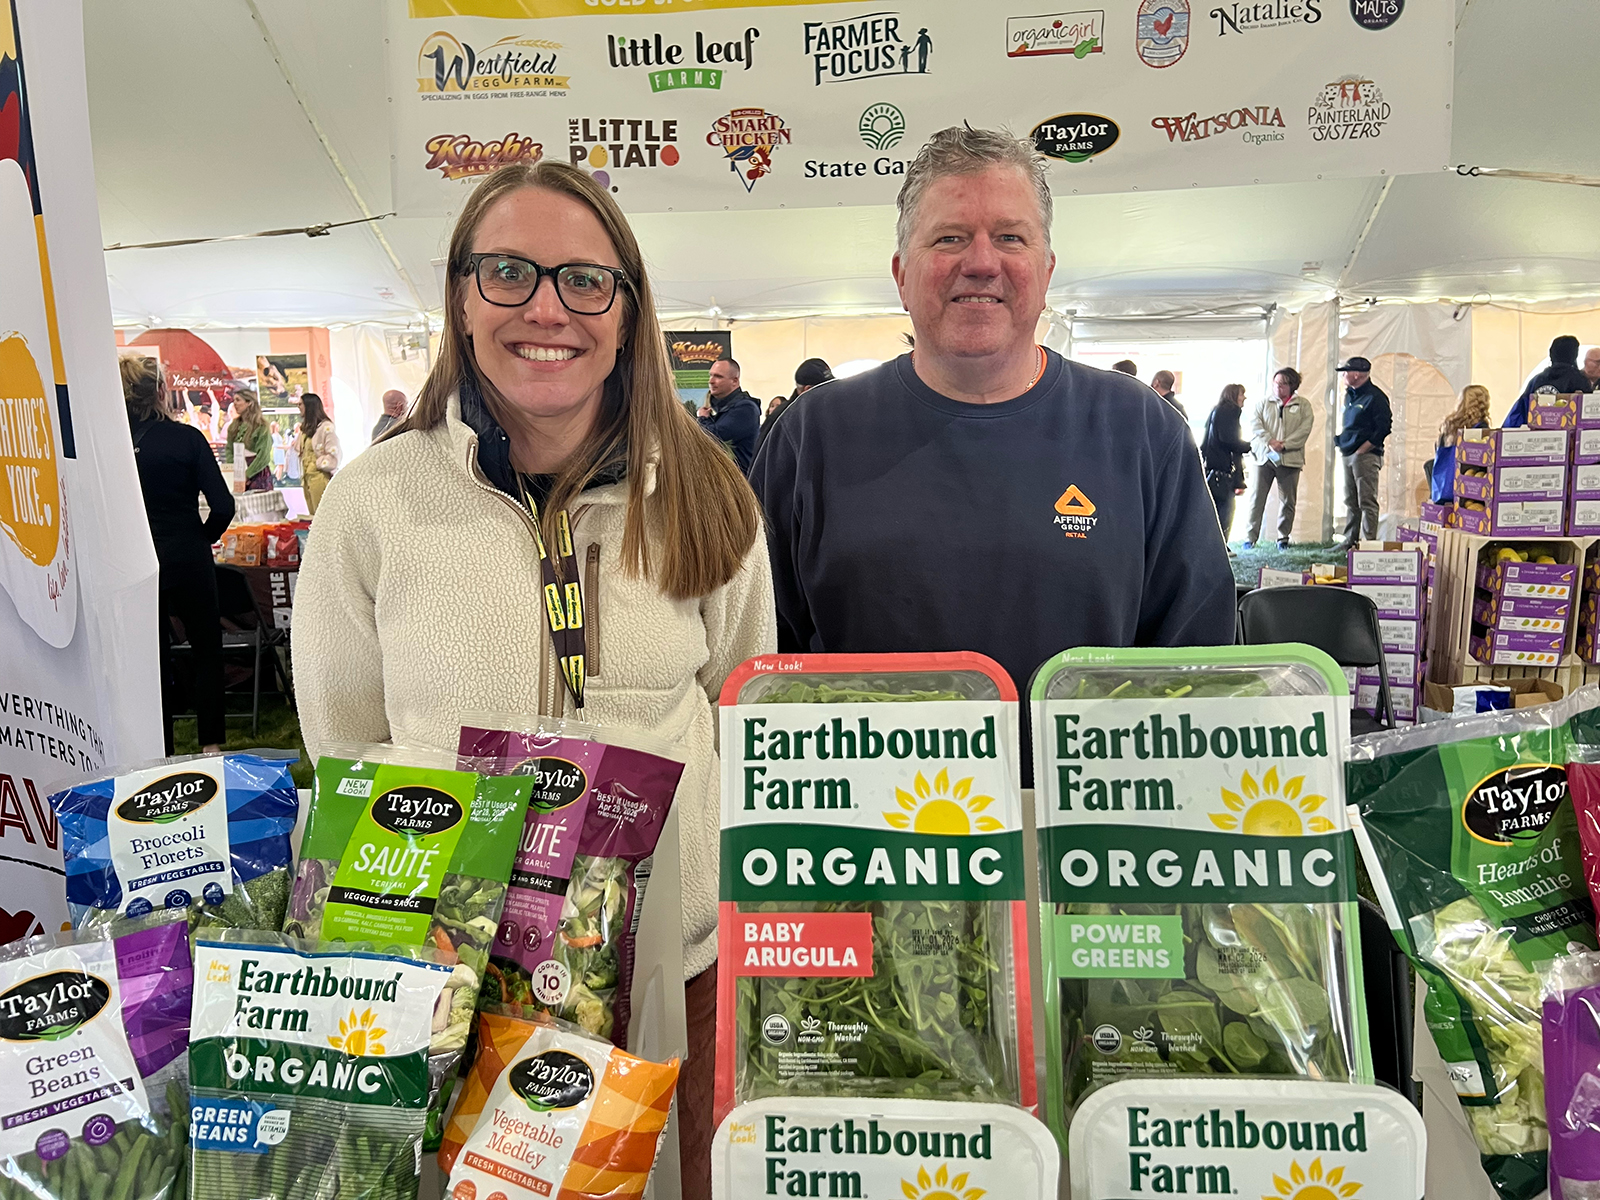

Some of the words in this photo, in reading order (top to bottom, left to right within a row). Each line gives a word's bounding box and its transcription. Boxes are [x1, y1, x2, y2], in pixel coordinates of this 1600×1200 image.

[803, 17, 903, 56] FARMER
[1013, 18, 1095, 49] organicgirl
[607, 32, 684, 69] little
[695, 27, 760, 71] leaf
[423, 42, 557, 92] Westfield
[813, 45, 896, 87] FOCUS
[473, 77, 500, 89] EGG
[514, 76, 555, 86] FARM
[653, 71, 718, 89] FARMS
[421, 93, 461, 101] SPECIALIZING
[1151, 105, 1287, 143] WATSONIA
[1307, 103, 1391, 125] PAINTERLAND
[568, 118, 580, 143] THE
[716, 115, 778, 134] SMART
[1040, 122, 1109, 142] Taylor
[1308, 121, 1388, 141] SISTERS
[706, 128, 792, 147] CHICKEN
[1055, 141, 1094, 151] FARMS
[1242, 131, 1286, 146] Organics
[425, 132, 543, 171] Koch's
[804, 159, 867, 179] State
[672, 340, 724, 354] Koch's
[1053, 515, 1098, 527] AFFINITY
[270, 572, 287, 606] THE
[753, 660, 775, 671] New
[778, 661, 803, 671] Look!
[1061, 653, 1083, 663] New
[1088, 653, 1115, 664] Look!
[743, 715, 997, 761] Earthbound
[1054, 711, 1328, 760] Earthbound
[345, 780, 369, 790] NEW
[521, 764, 581, 795] Taylor
[743, 766, 852, 811] Farm
[1056, 764, 1176, 812] Farm
[133, 777, 205, 809] Taylor
[342, 787, 367, 796] LOOK!
[597, 791, 616, 804] BEST
[623, 798, 639, 809] Used
[145, 800, 190, 817] FARMS
[387, 793, 453, 820] Taylor
[470, 800, 486, 809] BEST
[491, 801, 508, 809] Used
[598, 801, 612, 812] Apr
[623, 806, 638, 818] 2026
[393, 817, 433, 830] FARMS
[1501, 811, 1552, 833] FARMS
[130, 825, 206, 855] Broccoli
[140, 845, 204, 870] Florets
[353, 842, 441, 880] SAUTÉ
[524, 857, 551, 870] GARLIC
[742, 847, 1004, 886] ORGANIC
[132, 874, 159, 890] FRESH
[160, 862, 222, 882] VEGETABLES
[1060, 849, 1337, 888] ORGANIC
[1476, 852, 1539, 886] Hearts
[370, 878, 406, 890] TERIYAKI
[530, 876, 553, 889] SAUCE
[344, 891, 380, 905] VEGGIES
[394, 899, 421, 909] SAUCE
[1534, 906, 1569, 924] CHOPPED
[529, 933, 536, 945] 7
[744, 922, 805, 943] BABY
[912, 935, 925, 944] MAY
[928, 934, 938, 944] 01
[942, 934, 960, 945] 2026
[1070, 924, 1162, 943] POWER
[209, 960, 231, 972] New
[744, 946, 858, 967] ARUGULA
[1071, 948, 1170, 968] GREENS
[1236, 952, 1245, 962] 02
[1250, 952, 1268, 962] 2026
[537, 962, 561, 975] COOKS
[560, 970, 568, 979] IN
[237, 959, 403, 1003] Earthbound
[542, 976, 560, 990] 10
[0, 979, 93, 1020] Taylor
[536, 986, 564, 1002] MINUTES
[26, 1007, 79, 1032] FARMS
[234, 995, 310, 1033] Farm
[827, 1021, 868, 1034] Thoroughly
[834, 1033, 862, 1042] Washed
[1160, 1031, 1203, 1044] Thoroughly
[797, 1036, 825, 1044] NON-GMO
[1168, 1043, 1196, 1053] Washed
[25, 1045, 96, 1077] Green
[28, 1066, 101, 1099] Beans
[226, 1053, 382, 1094] ORGANIC
[527, 1058, 588, 1088] Taylor
[525, 1081, 561, 1099] FARMS
[7, 1109, 48, 1129] FRESH
[53, 1082, 130, 1113] VEGETABLES
[191, 1106, 253, 1126] GREEN
[189, 1122, 248, 1143] BEANS
[260, 1124, 286, 1134] VITAMIN
[269, 1133, 275, 1141] K
[493, 1108, 563, 1150] Vegetable
[729, 1132, 757, 1145] Look!
[764, 1114, 992, 1160] Earthbound
[1127, 1106, 1368, 1153] Earthbound
[485, 1131, 547, 1170] Medley
[467, 1154, 494, 1173] FRESH
[497, 1166, 548, 1194] VEGETABLES
[765, 1157, 862, 1198] Farm
[1129, 1152, 1231, 1194] Farm
